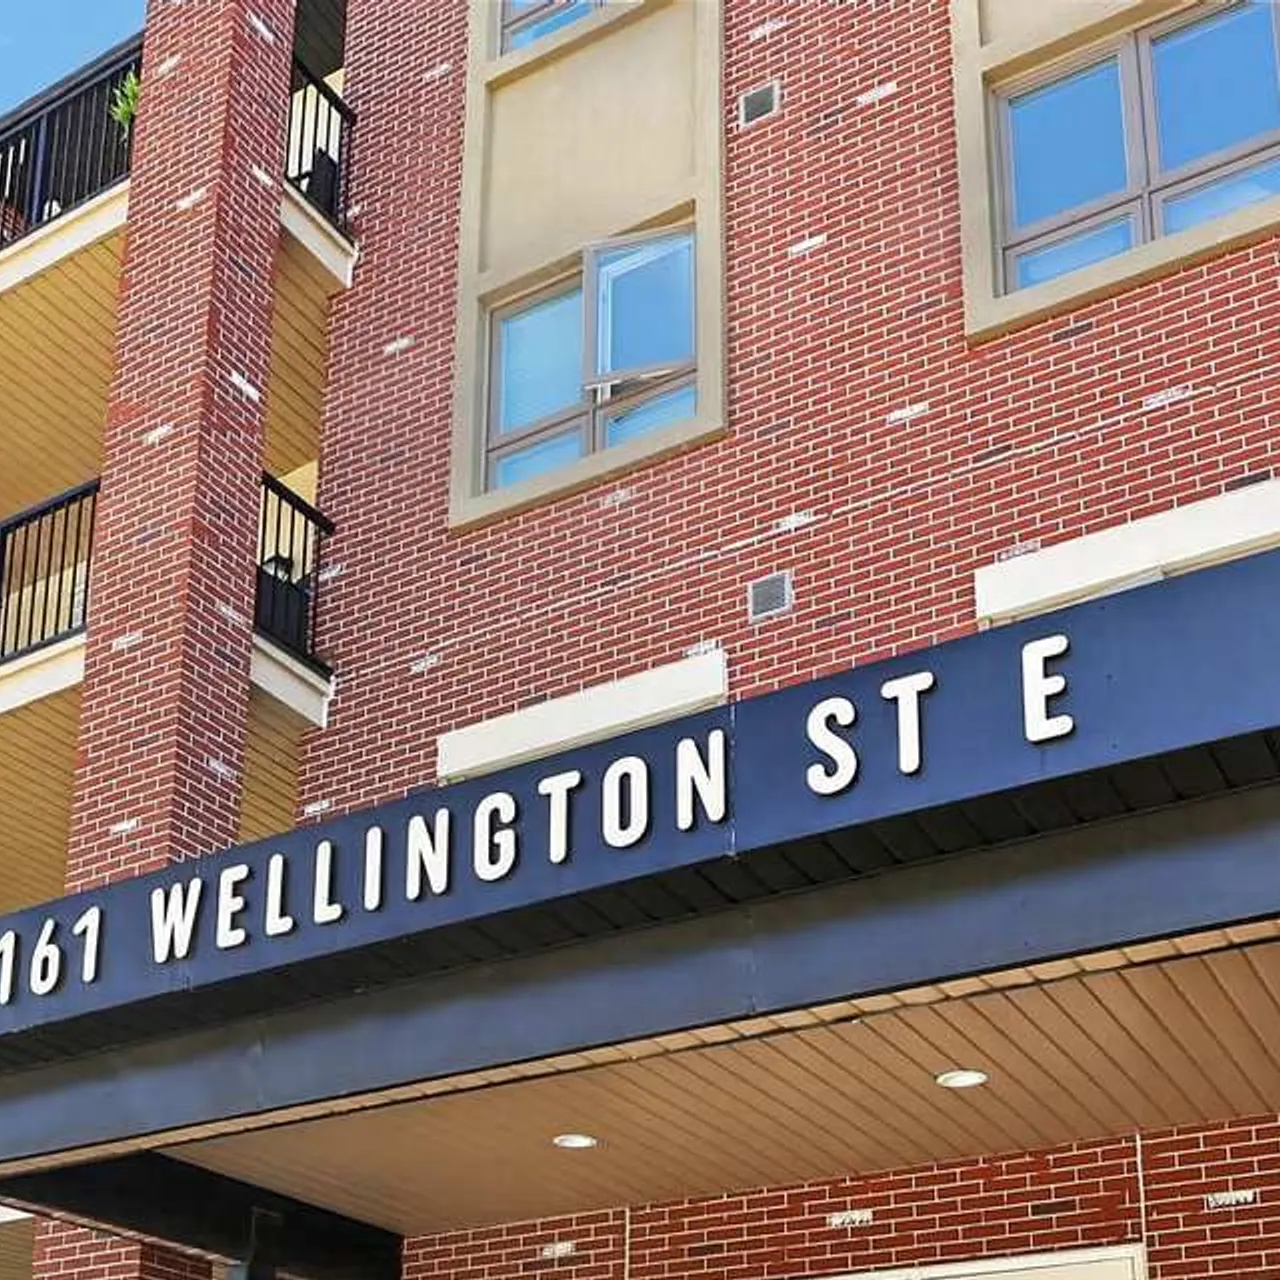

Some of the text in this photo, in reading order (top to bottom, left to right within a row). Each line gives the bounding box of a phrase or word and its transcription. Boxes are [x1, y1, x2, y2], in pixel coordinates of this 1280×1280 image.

[149, 727, 727, 964] WELLINGTON
[805, 670, 936, 796] ST
[1021, 634, 1075, 743] E
